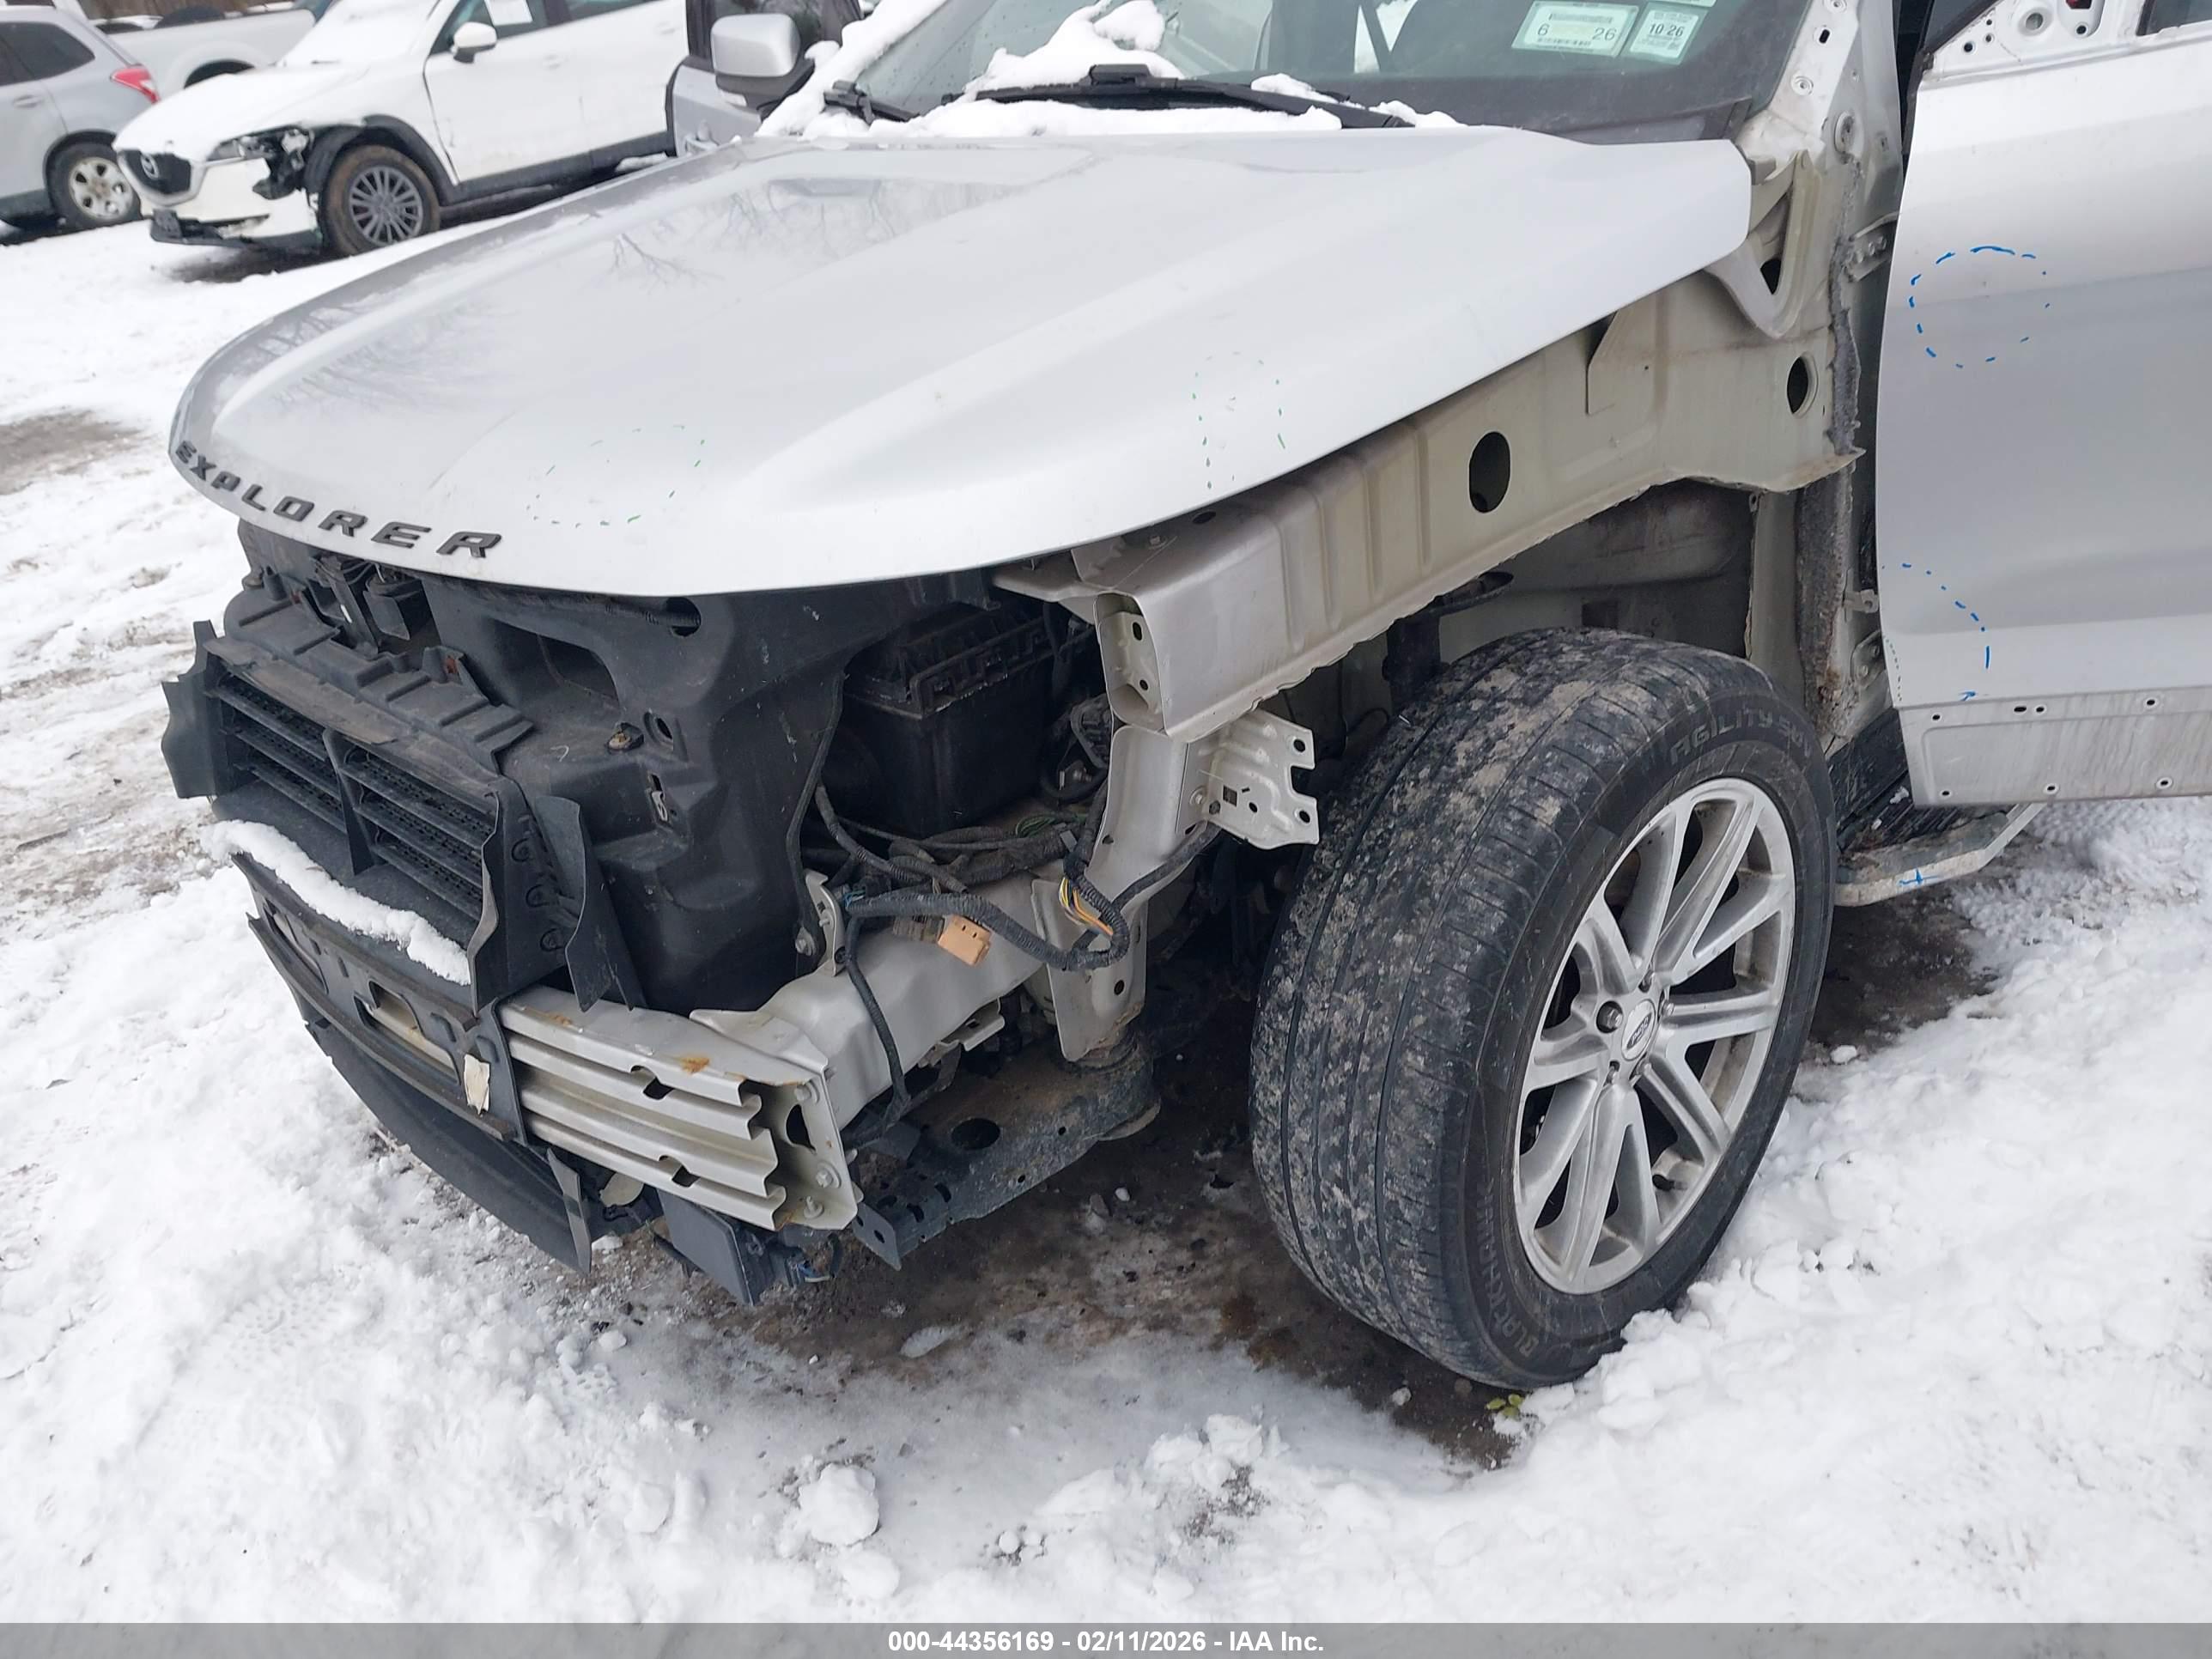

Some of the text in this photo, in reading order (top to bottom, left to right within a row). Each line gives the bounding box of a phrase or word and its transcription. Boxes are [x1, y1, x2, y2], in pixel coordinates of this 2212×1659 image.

[1537, 22, 1617, 41] 6 26
[1649, 22, 1685, 37] 10 26
[175, 440, 502, 560] EXPLORER
